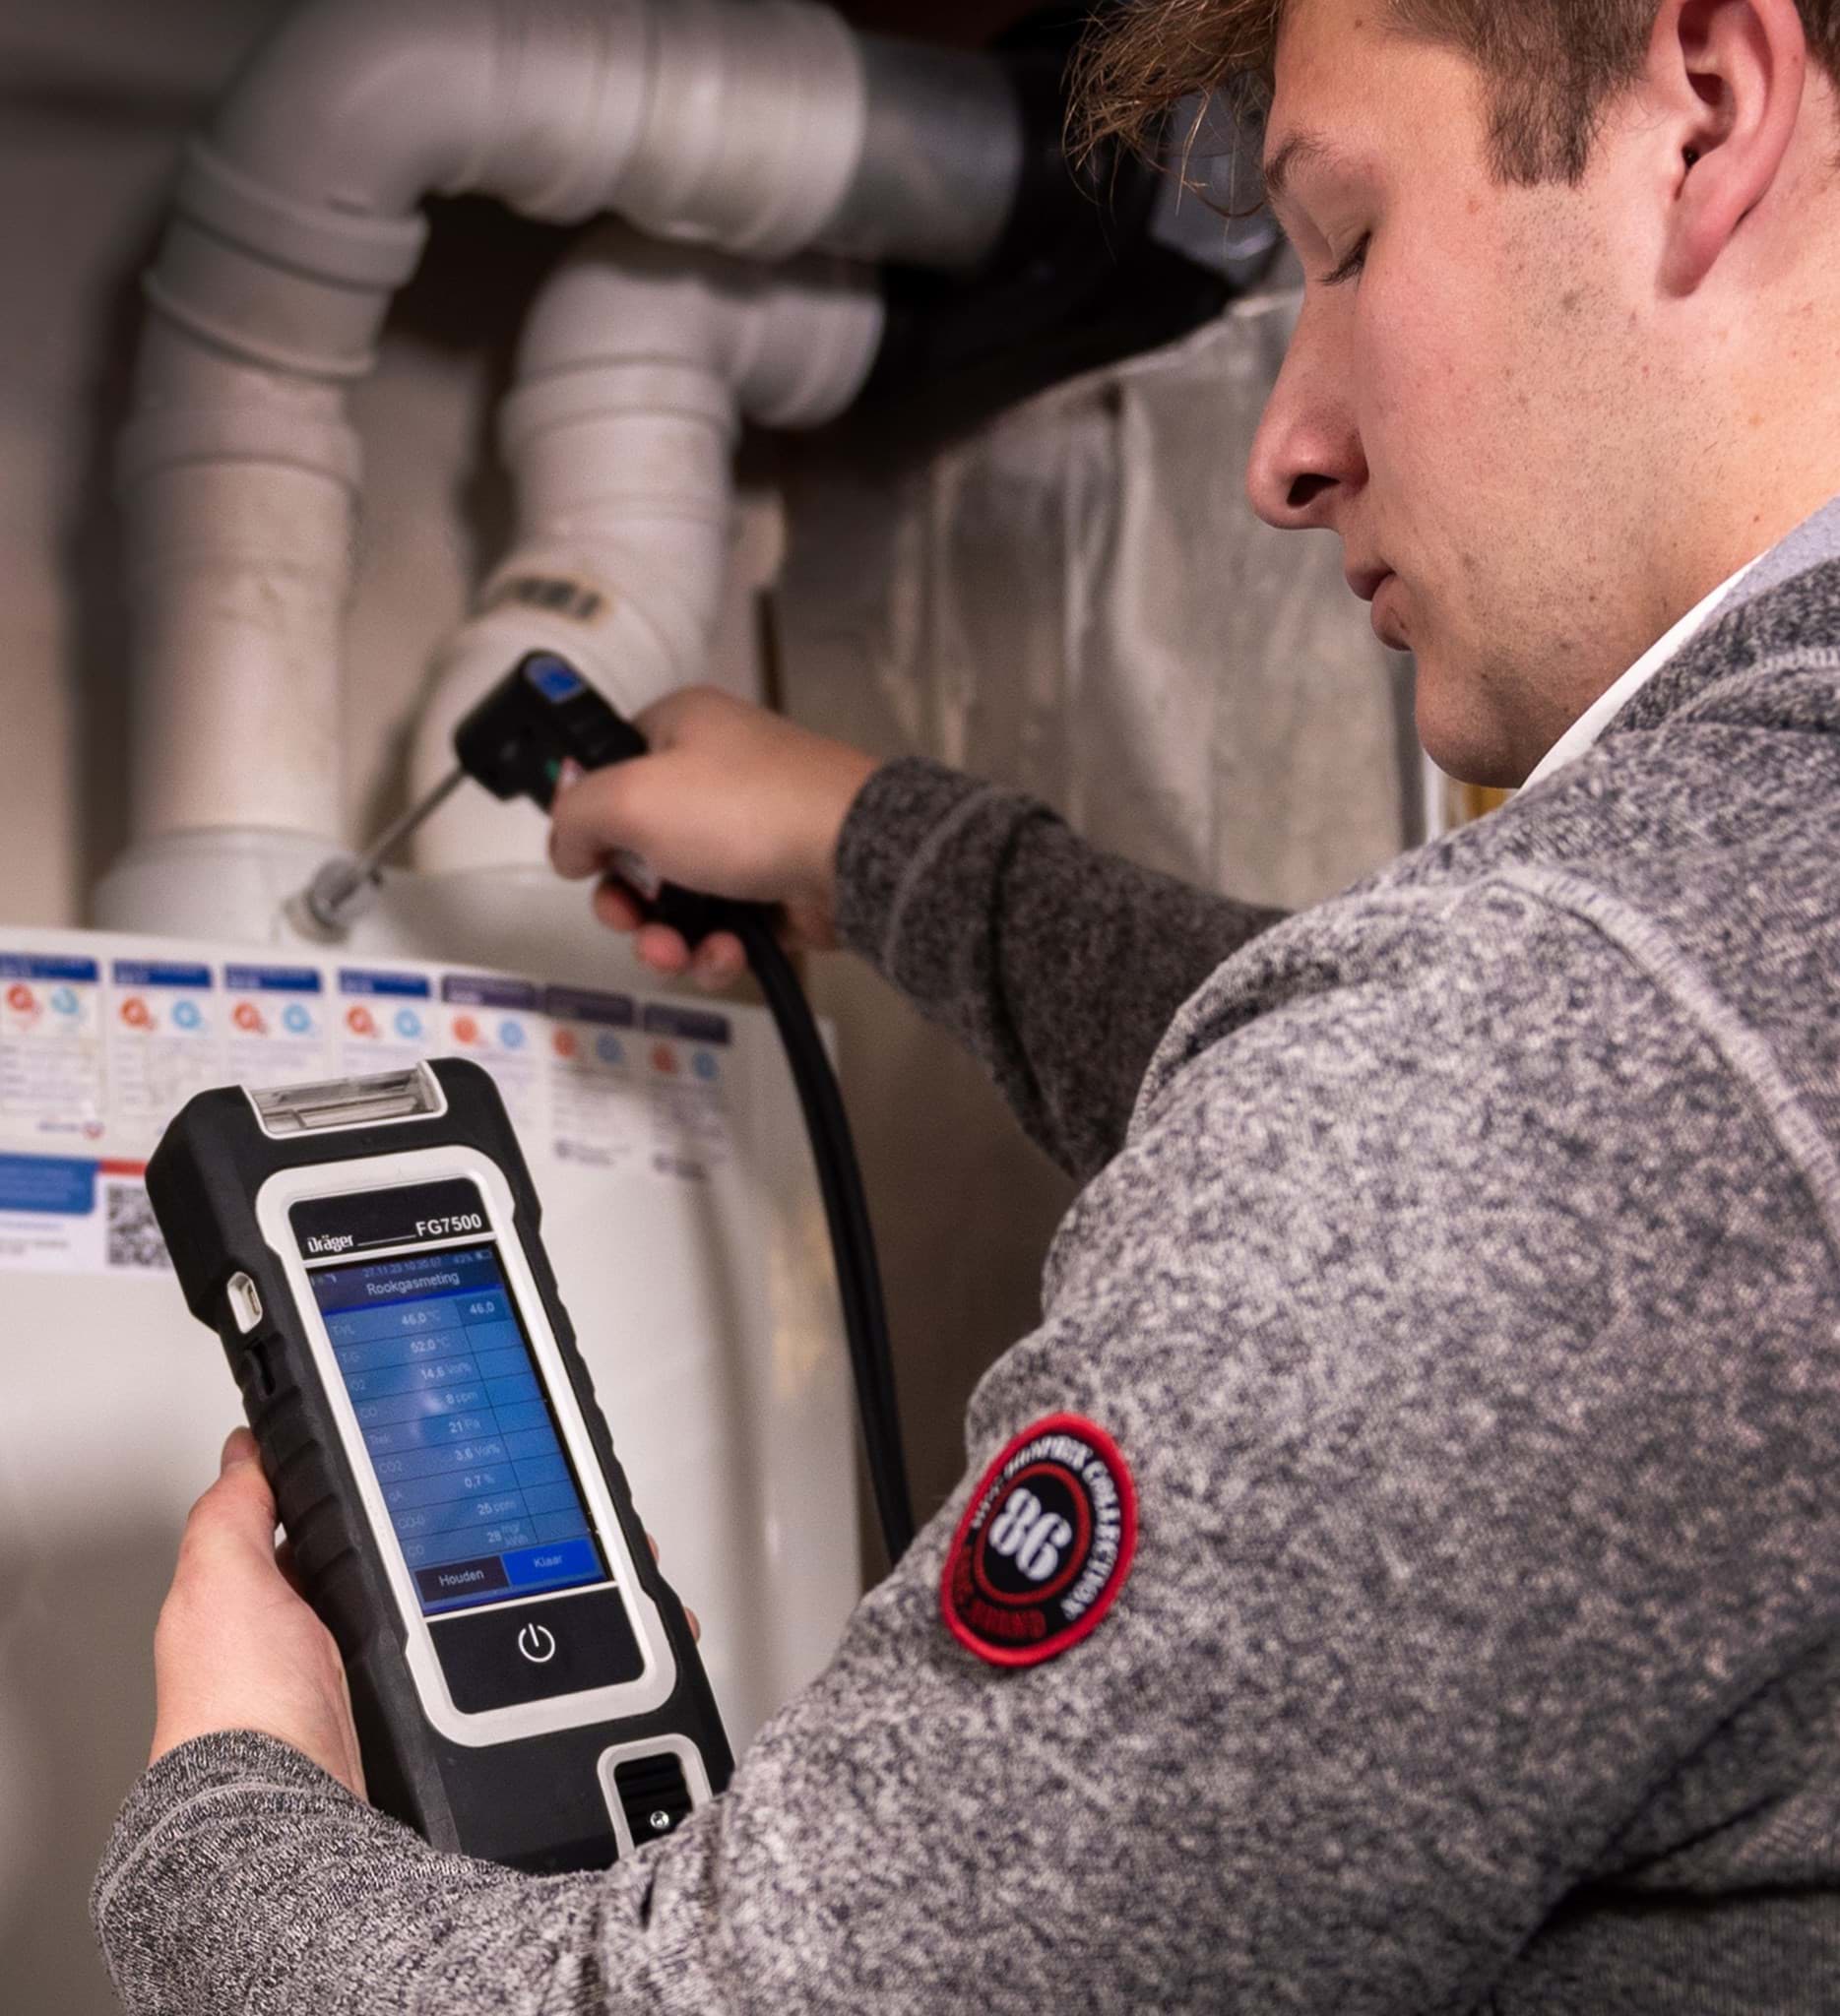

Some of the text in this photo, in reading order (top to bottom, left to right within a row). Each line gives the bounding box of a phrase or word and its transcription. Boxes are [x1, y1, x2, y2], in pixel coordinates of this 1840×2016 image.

[415, 1213, 482, 1237] FG7500
[306, 1232, 354, 1254] Dräger
[366, 1272, 460, 1296] Rookgasmeting
[469, 1301, 496, 1315] 46,0
[400, 1311, 427, 1326] 46,0
[410, 1339, 437, 1354] 52,0
[420, 1366, 446, 1380] 14,6
[445, 1393, 455, 1404] 8
[448, 1420, 464, 1432] 21
[377, 1460, 404, 1475] CO2
[463, 1475, 483, 1489] 0,7
[988, 1487, 1073, 1581] 86
[1060, 1460, 1120, 1621] COLLECTION
[533, 1554, 564, 1568] Klaar
[438, 1568, 485, 1586] Houden
